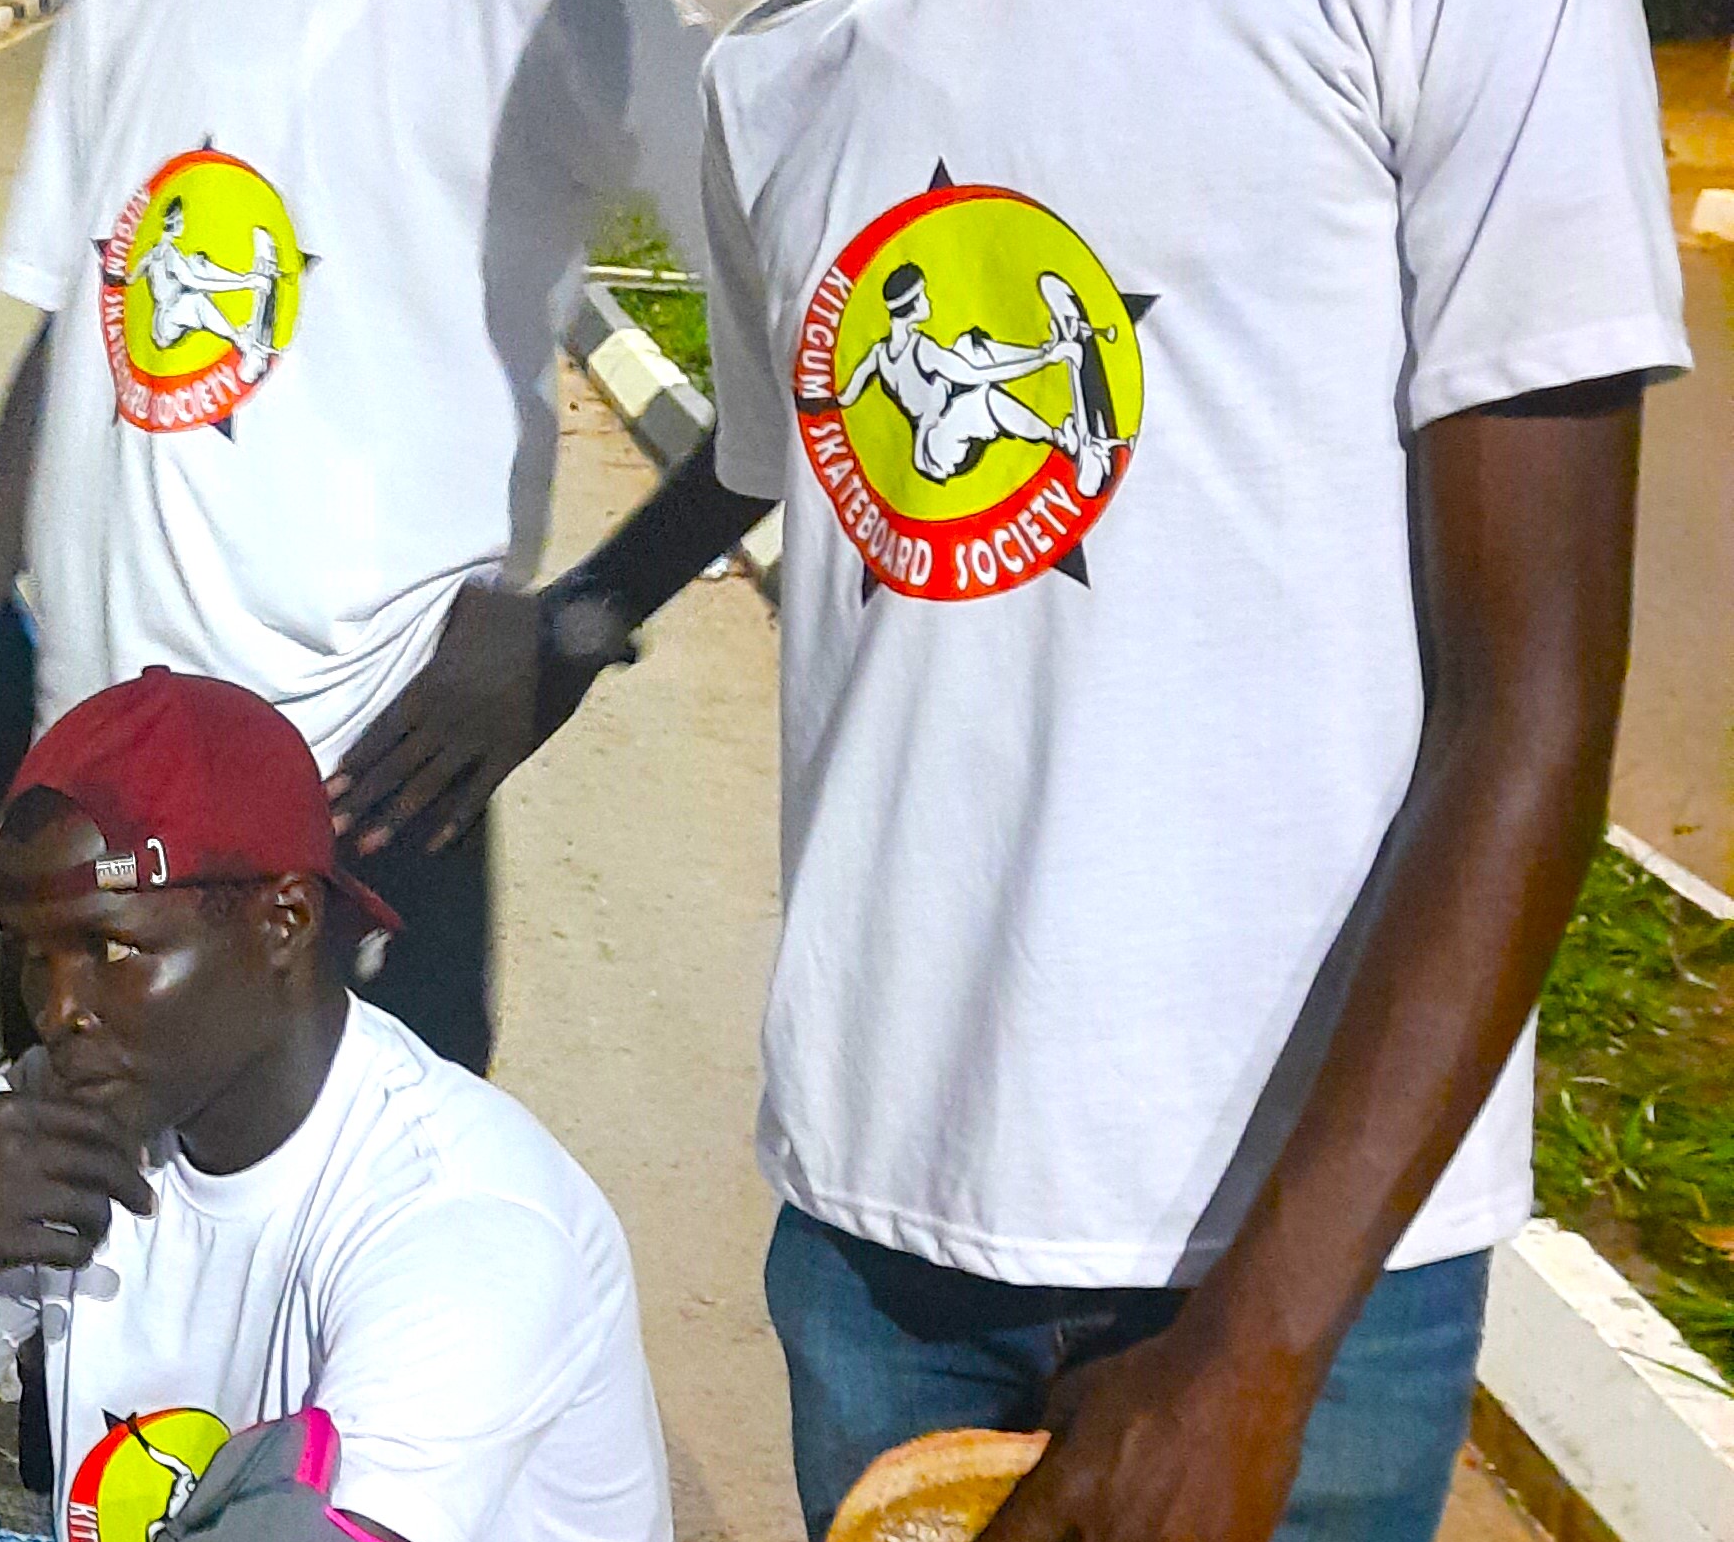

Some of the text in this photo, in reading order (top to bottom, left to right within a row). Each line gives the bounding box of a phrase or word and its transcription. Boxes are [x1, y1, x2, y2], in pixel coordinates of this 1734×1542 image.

[799, 265, 1083, 591] KITGUM SKATEBOARD SOCIETY
